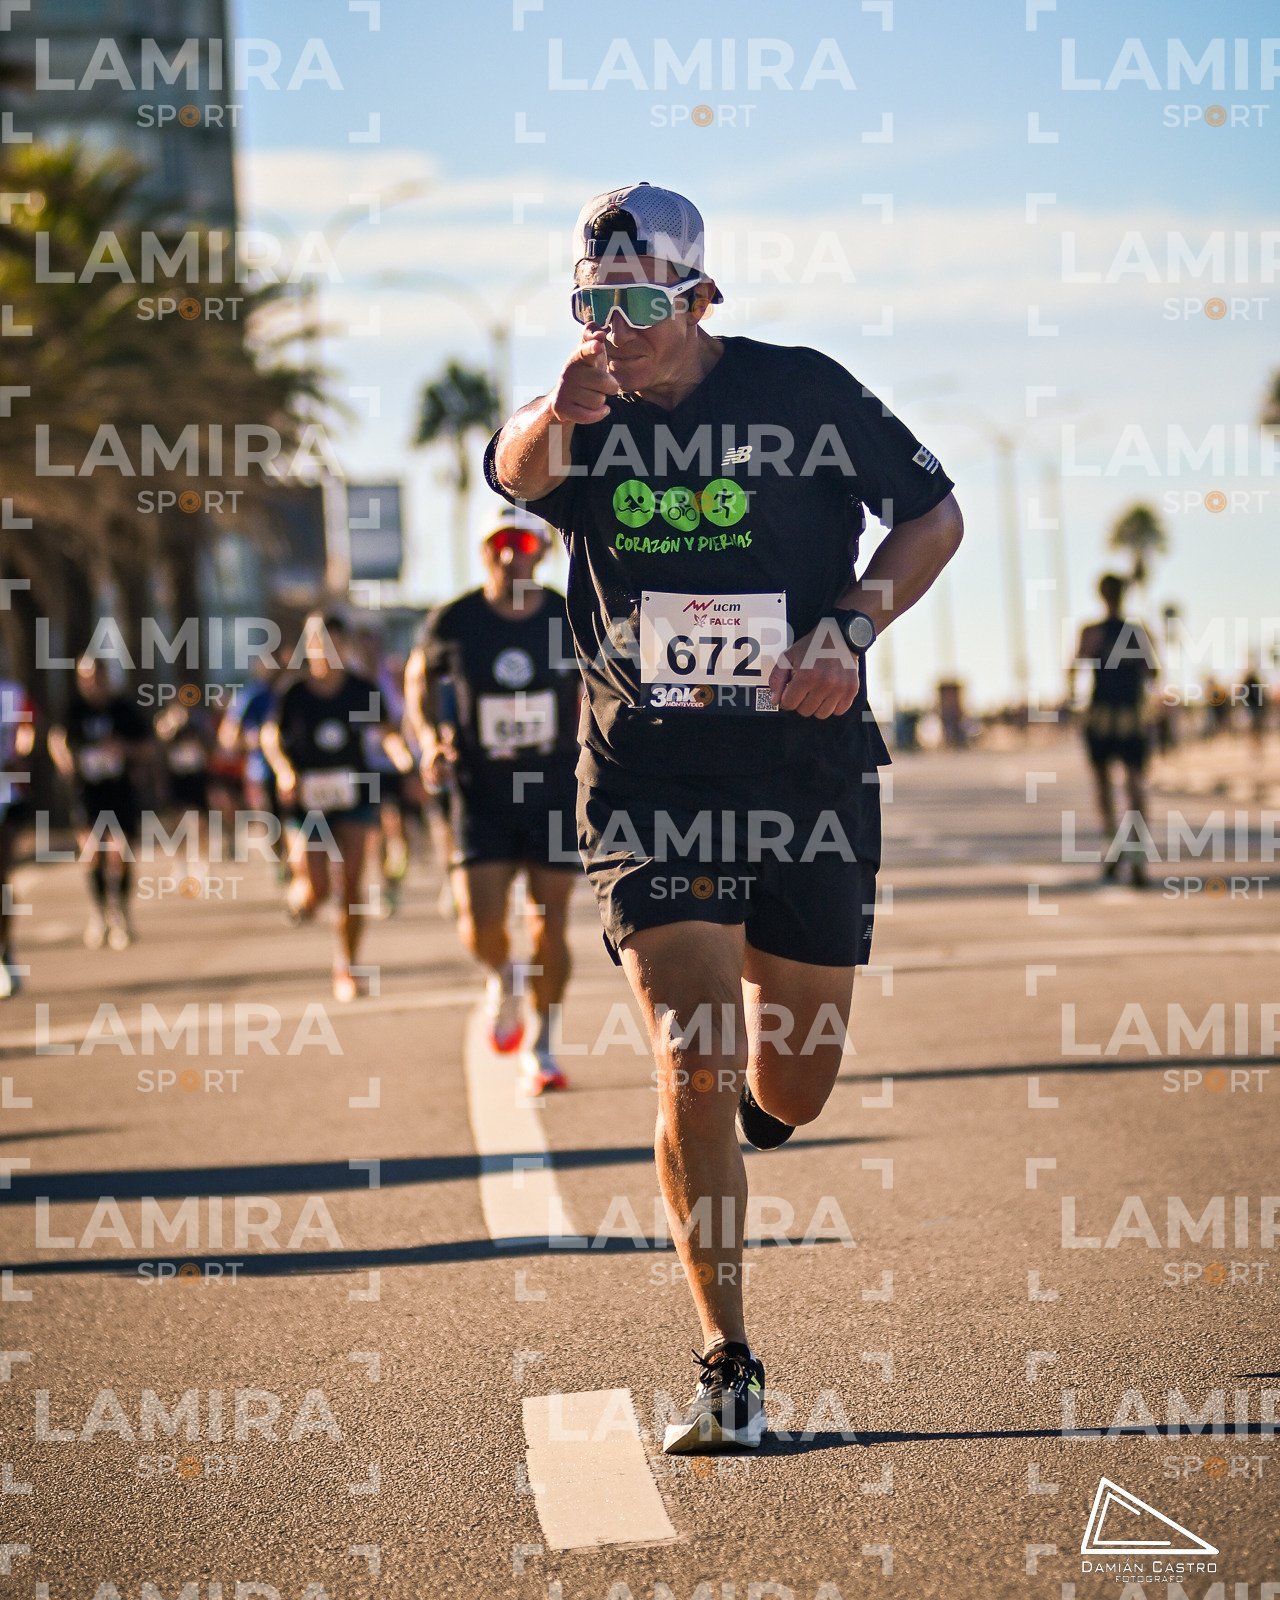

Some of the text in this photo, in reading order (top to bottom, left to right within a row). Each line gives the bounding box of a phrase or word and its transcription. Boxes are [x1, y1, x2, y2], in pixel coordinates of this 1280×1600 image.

[615, 531, 753, 554] CORAZÓN Y PIERNAS
[713, 602, 741, 612] ucm
[709, 617, 741, 626] FALCK
[666, 634, 762, 677] 672
[650, 687, 702, 708] 30K
